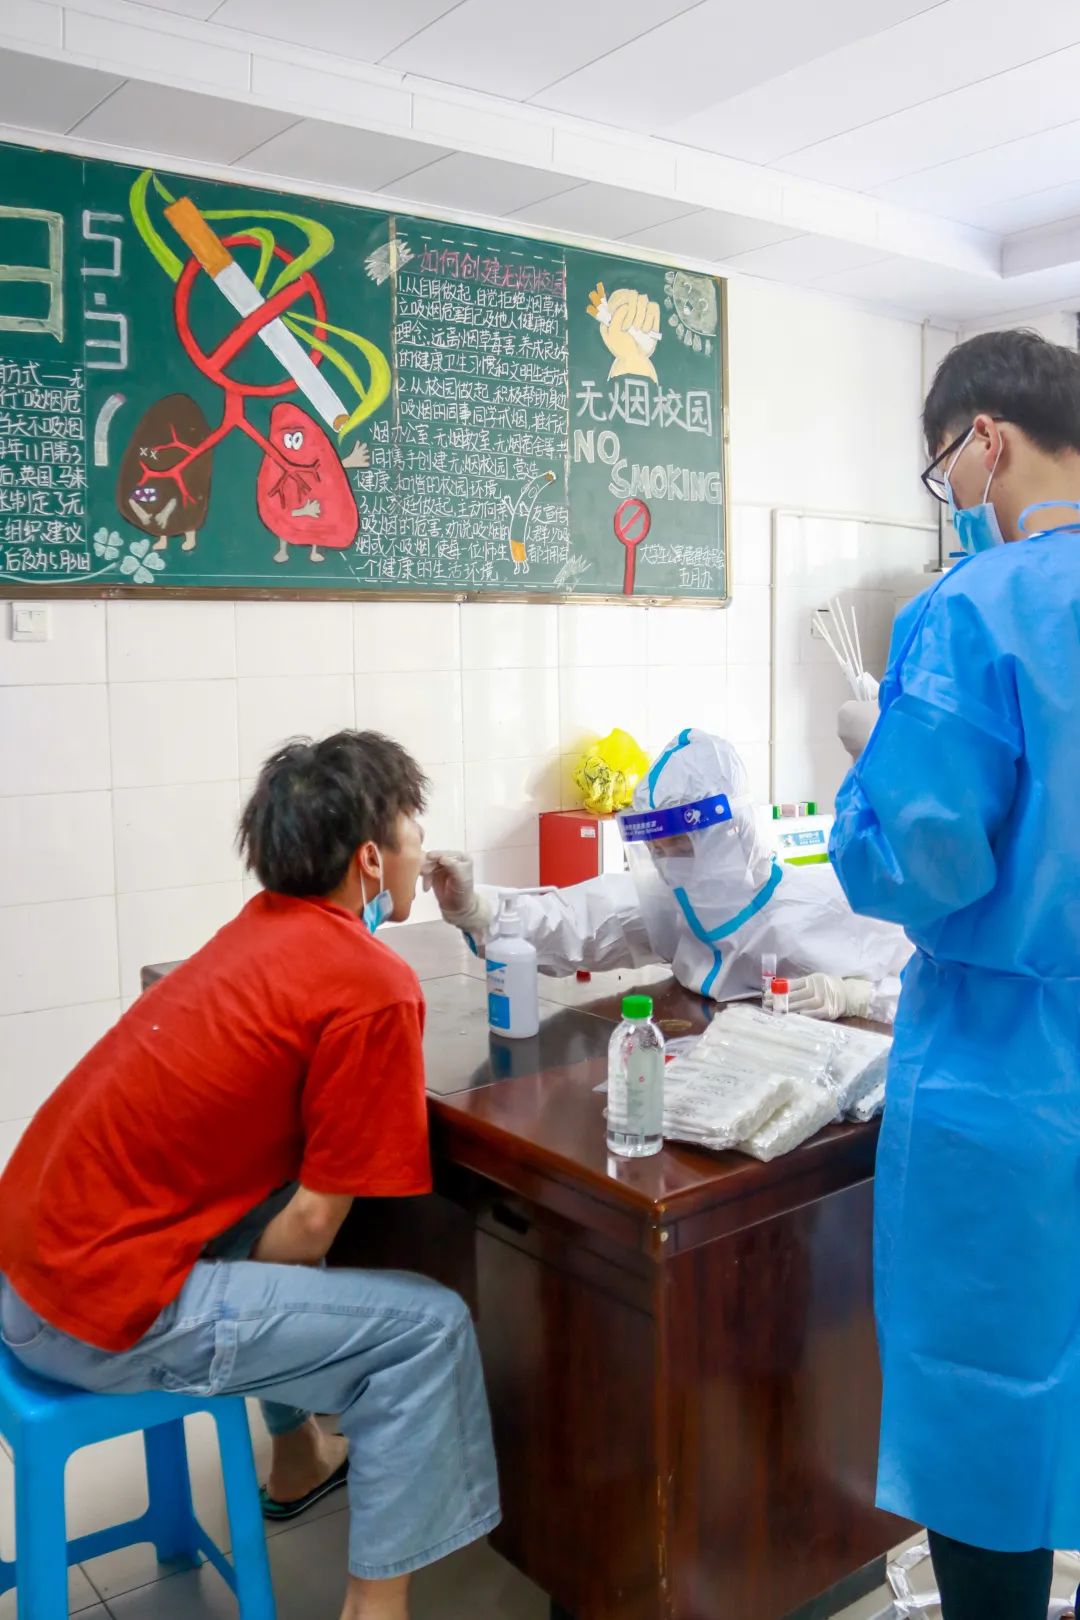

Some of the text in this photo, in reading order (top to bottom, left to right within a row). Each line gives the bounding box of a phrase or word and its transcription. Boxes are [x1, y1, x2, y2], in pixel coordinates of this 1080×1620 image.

[576, 378, 712, 437] 无烟校园
[574, 429, 620, 465] NO
[608, 458, 722, 505] SMOKING
